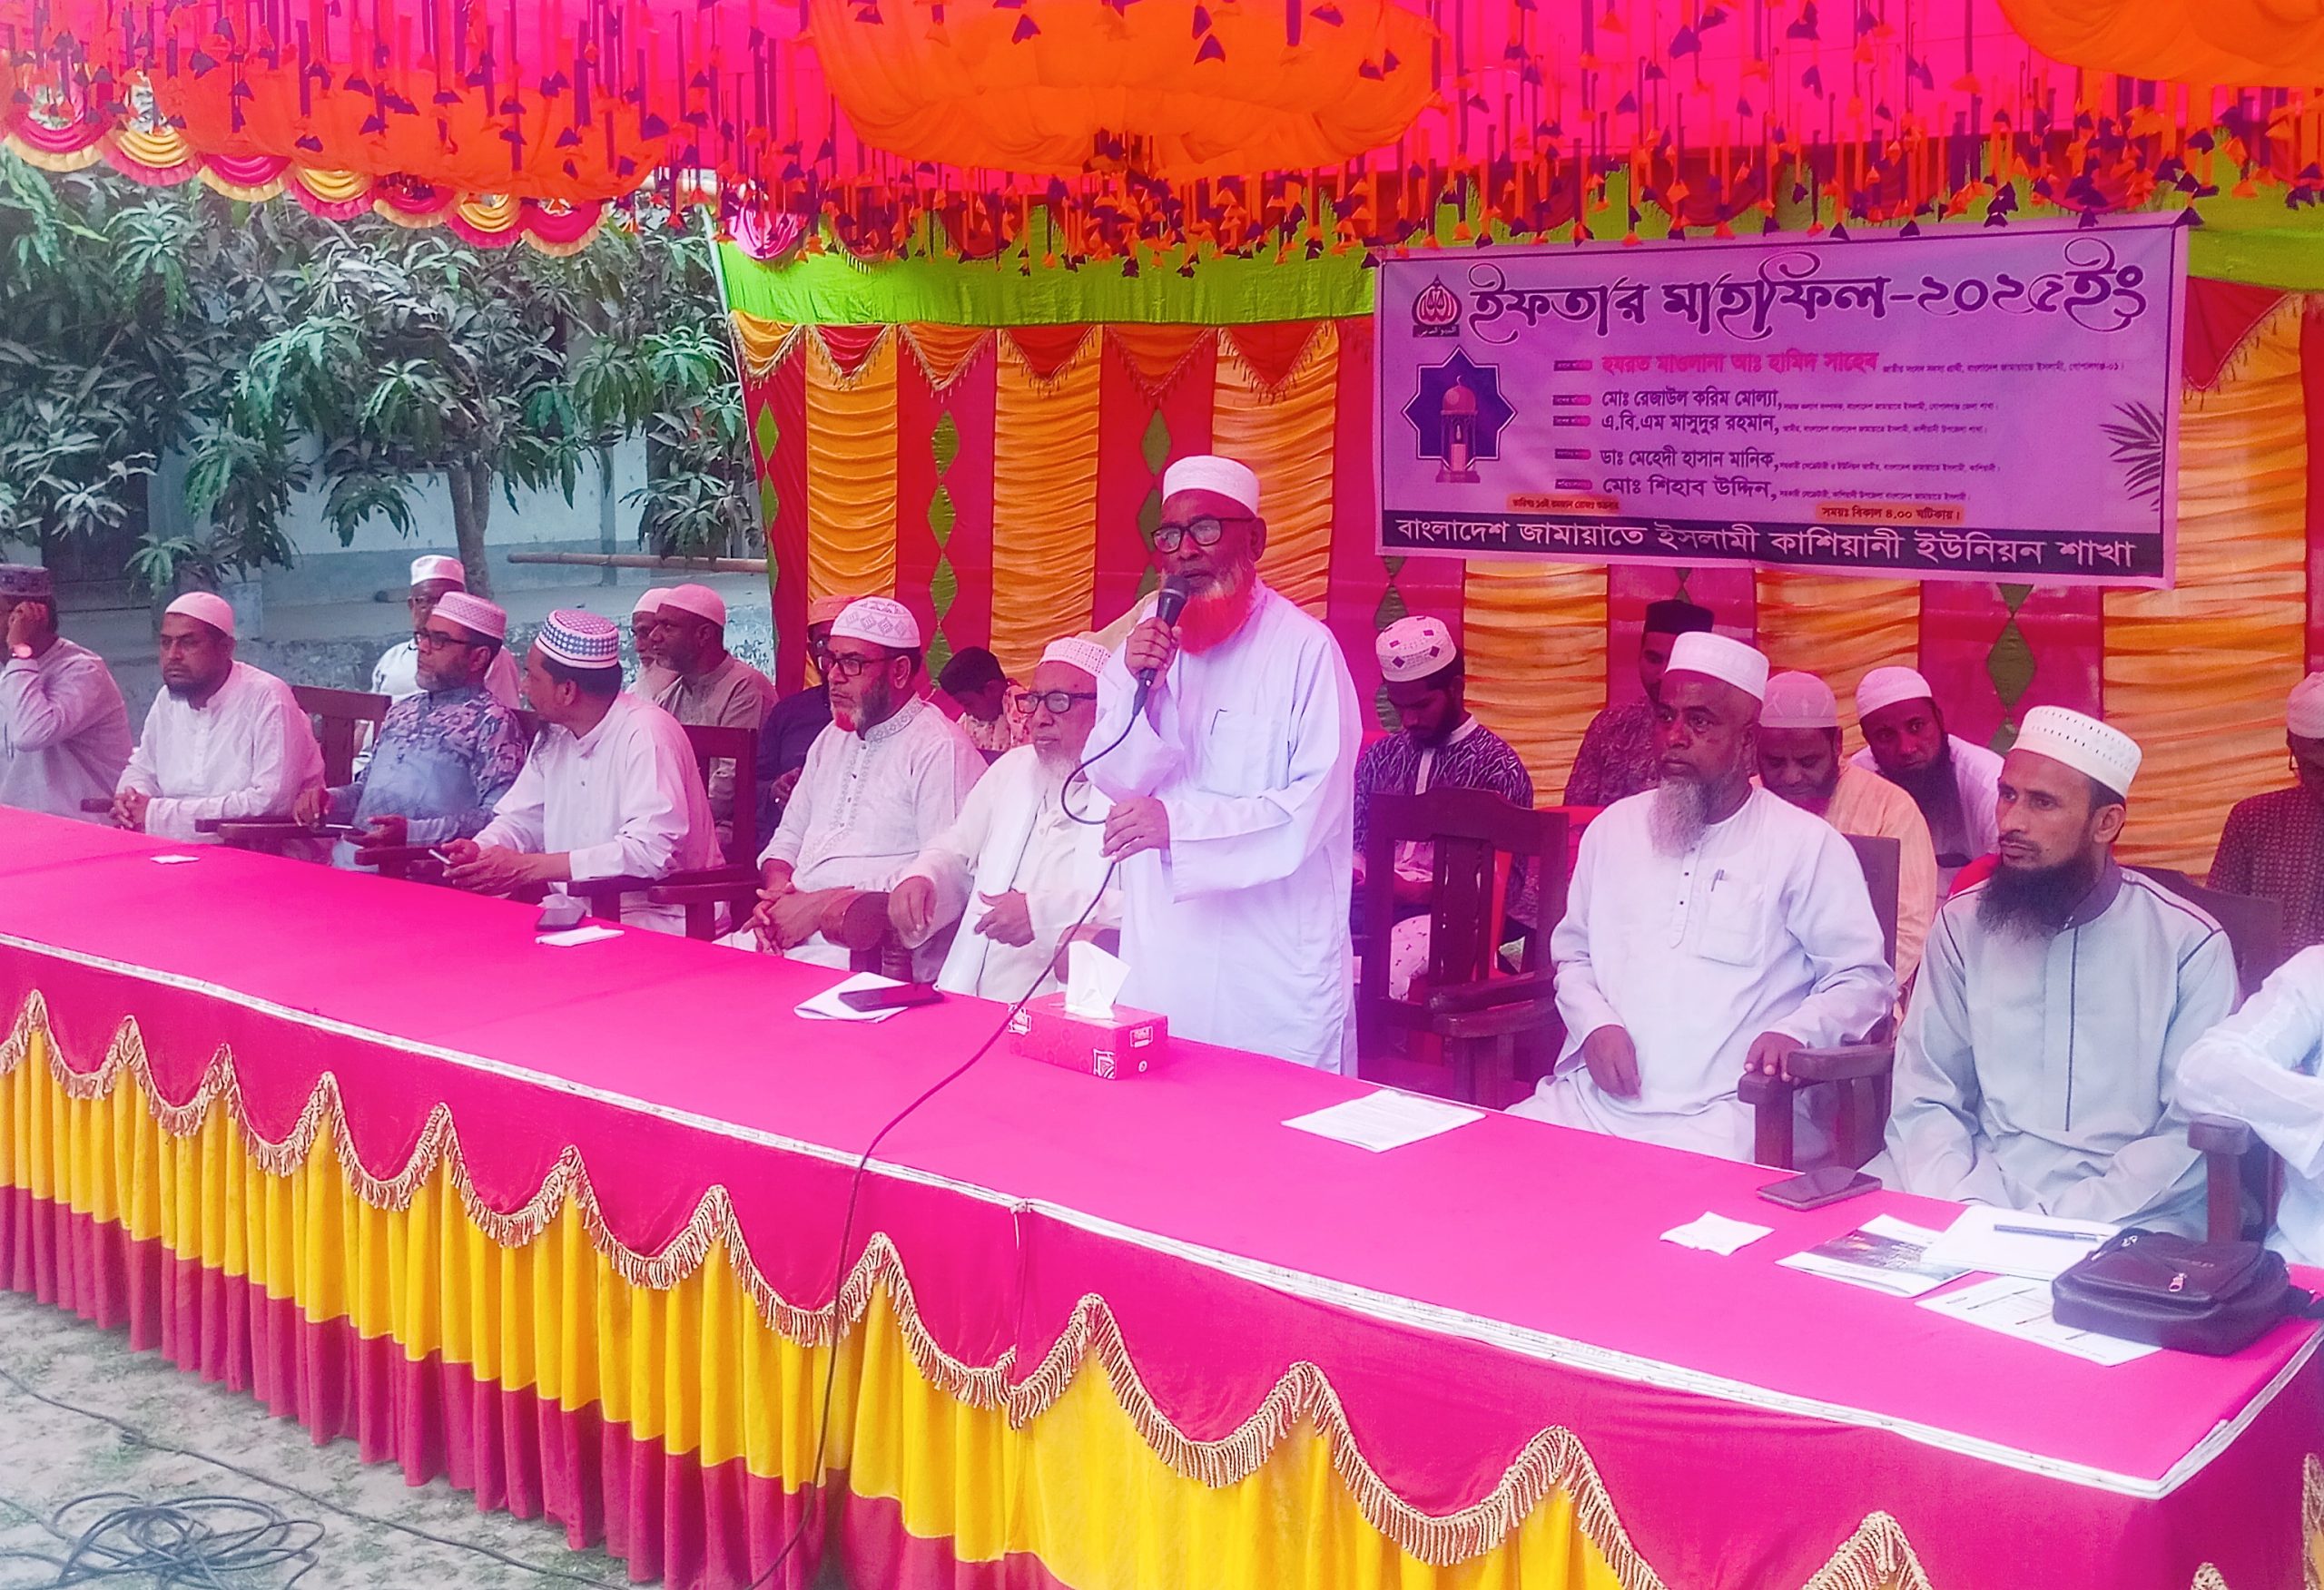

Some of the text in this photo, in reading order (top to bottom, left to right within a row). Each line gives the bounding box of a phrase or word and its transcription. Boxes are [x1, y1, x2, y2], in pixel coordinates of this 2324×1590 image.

[1468, 262, 1650, 344] ইফতার
[1601, 389, 1630, 407] মোঃ
[1634, 386, 1688, 407] রেজাউল
[1692, 386, 1731, 407] করিম
[1601, 409, 1666, 431] এ.বি.এম
[1669, 414, 1720, 435] মাসুদুর
[1725, 414, 1779, 435] রহমান,
[1600, 448, 1624, 466] ডাঃ
[1629, 444, 1678, 468] মেহেদী
[1682, 450, 1725, 469] হাসান
[1728, 446, 1779, 472] মানিক,
[1603, 476, 1641, 496] মোঃ
[1648, 474, 1708, 498] শিহাব
[1713, 474, 1777, 501] উদ্দিন,
[1852, 505, 1882, 518] বিকাল
[1886, 508, 1912, 520] ৪.০০
[1395, 517, 2137, 567] বাংলাদেশ জামায়াতে ইসলামী কাশিয়ানী ইউনিয়ন শাখা
